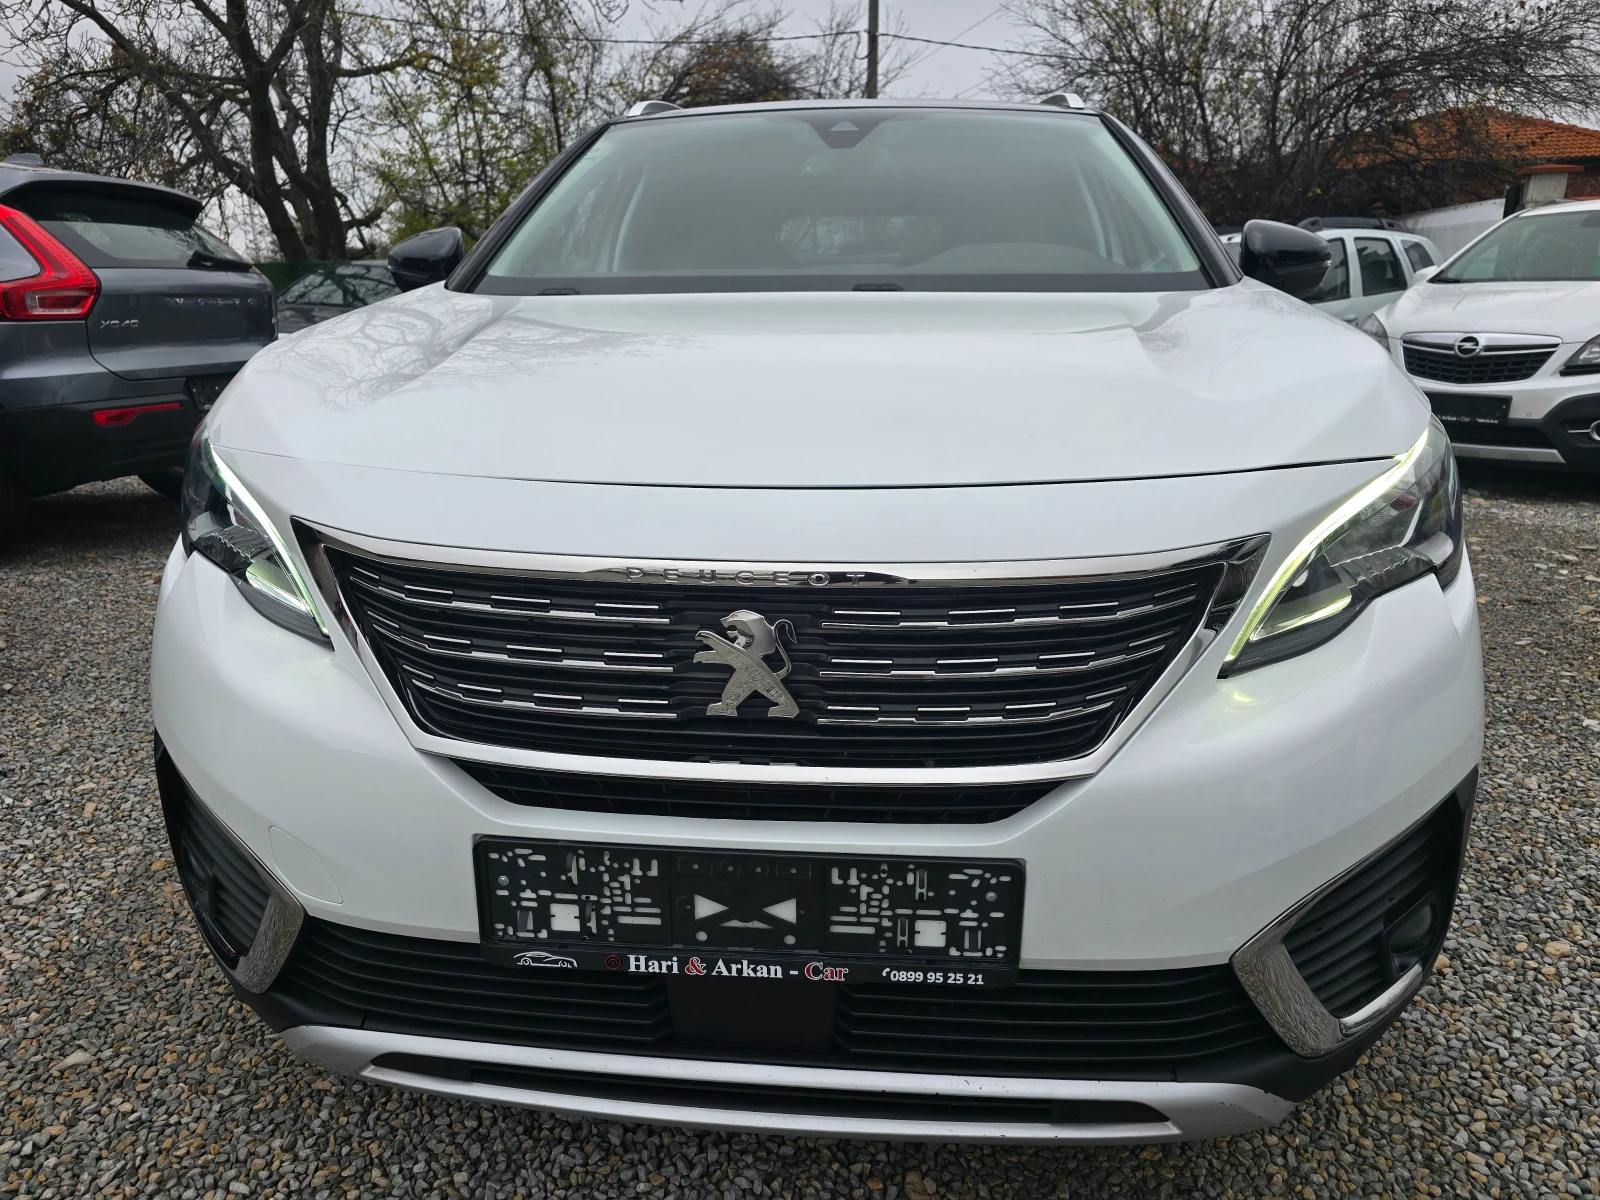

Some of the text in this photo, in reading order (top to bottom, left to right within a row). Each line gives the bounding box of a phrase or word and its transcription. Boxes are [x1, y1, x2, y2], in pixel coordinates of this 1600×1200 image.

[100, 319, 139, 329] XC40
[626, 566, 865, 586] PEUGEOT
[627, 954, 680, 974] Hari
[684, 956, 707, 976] &
[711, 958, 783, 978] Arkan
[804, 962, 849, 982] Car
[890, 971, 984, 985] 0899 95 25 21
